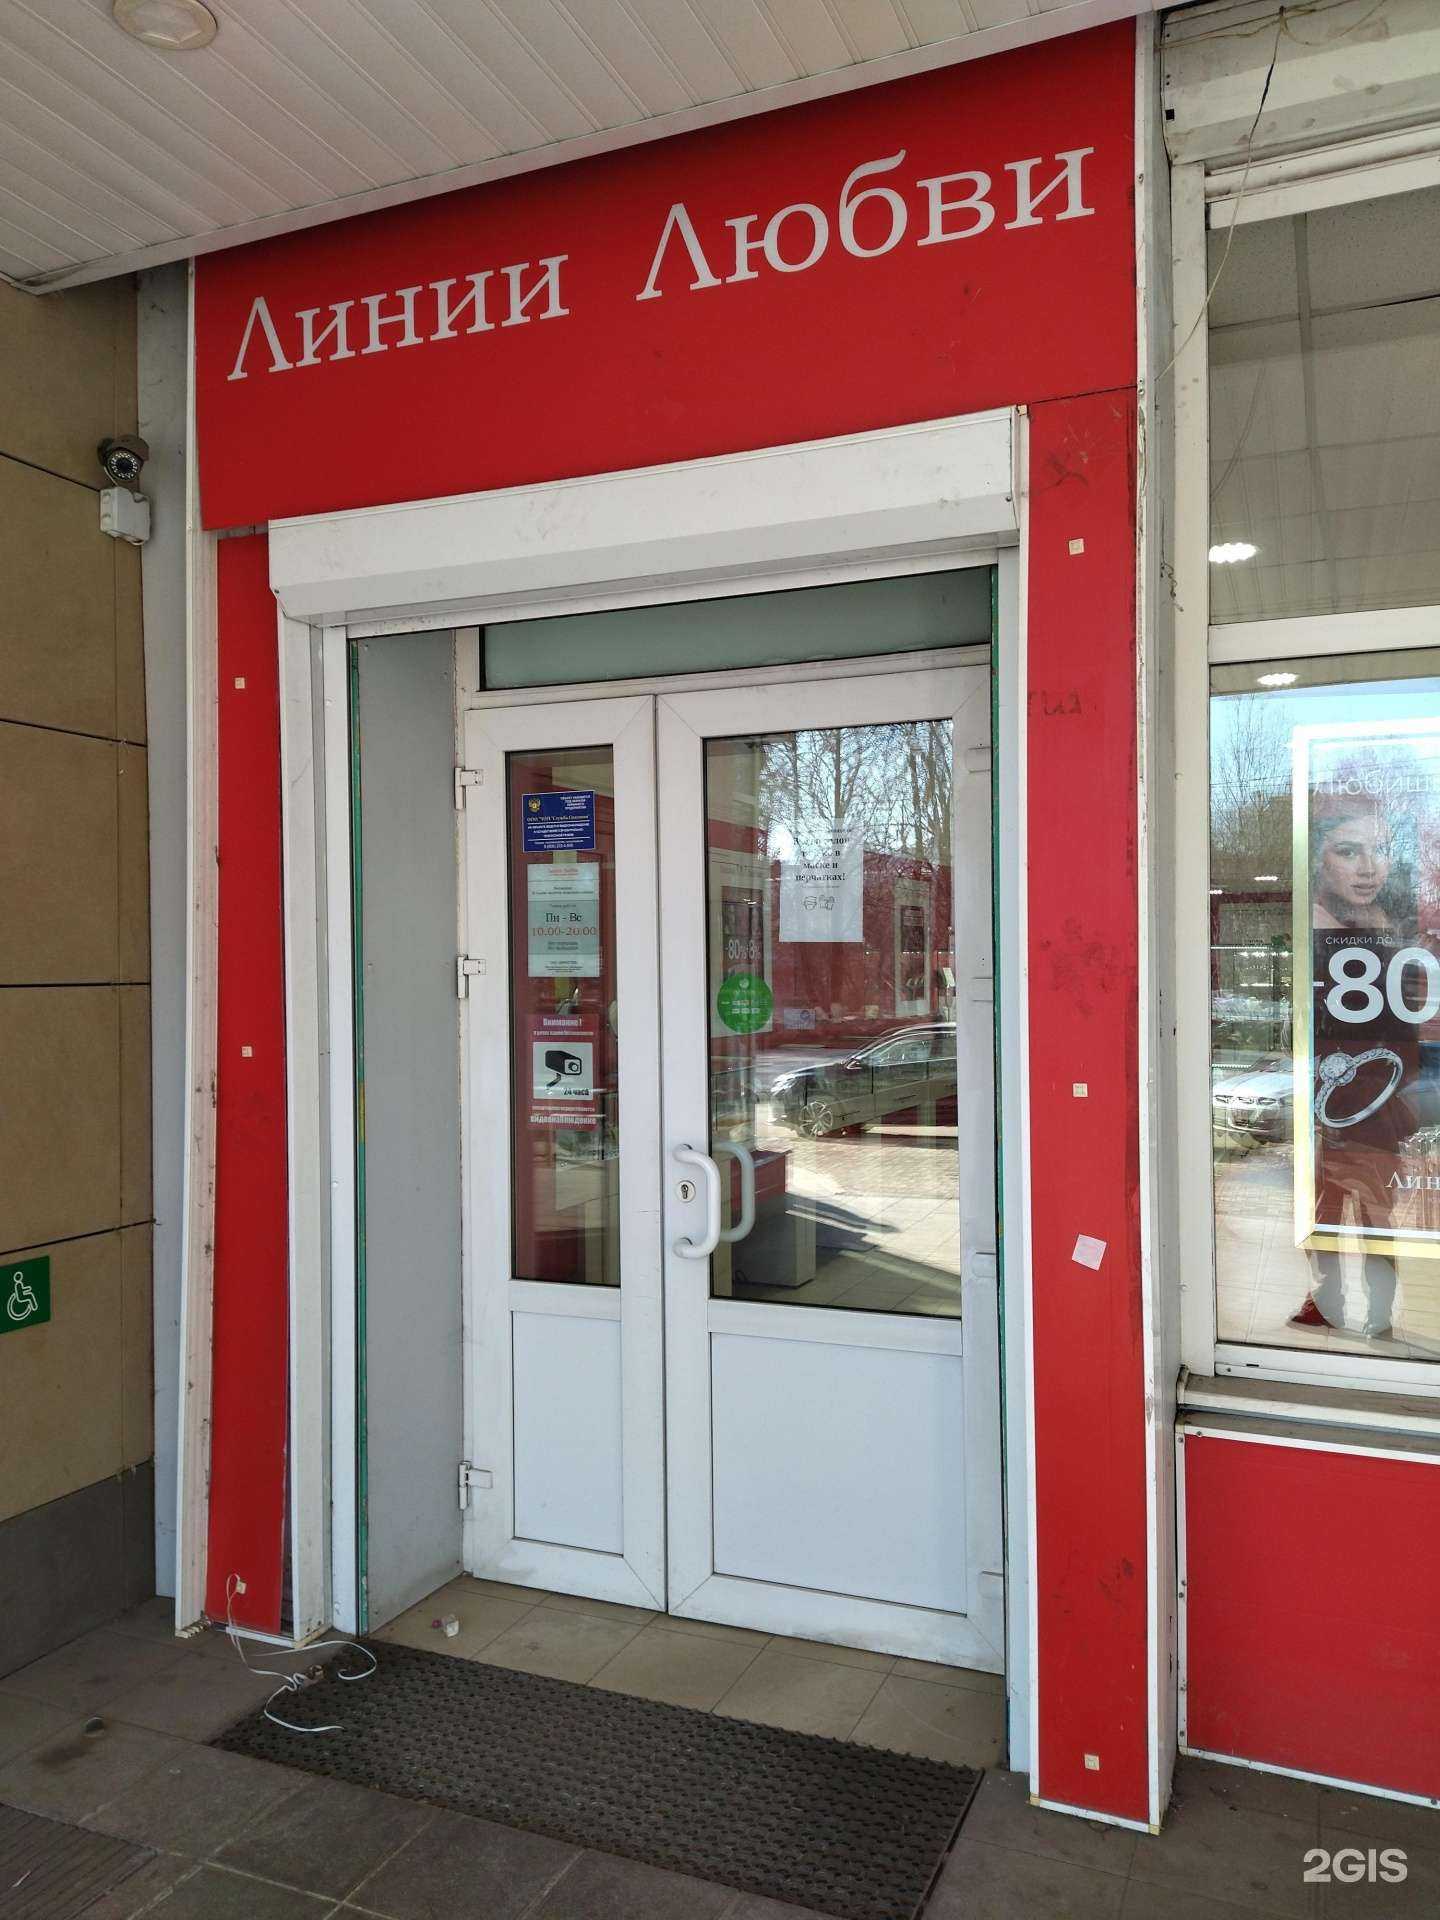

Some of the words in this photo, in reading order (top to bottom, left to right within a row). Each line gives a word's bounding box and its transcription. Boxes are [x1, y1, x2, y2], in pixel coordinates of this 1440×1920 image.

[227, 254, 570, 382] Линии
[636, 146, 1096, 301] Любви
[546, 912, 560, 923] Пн
[569, 912, 583, 922] Вс
